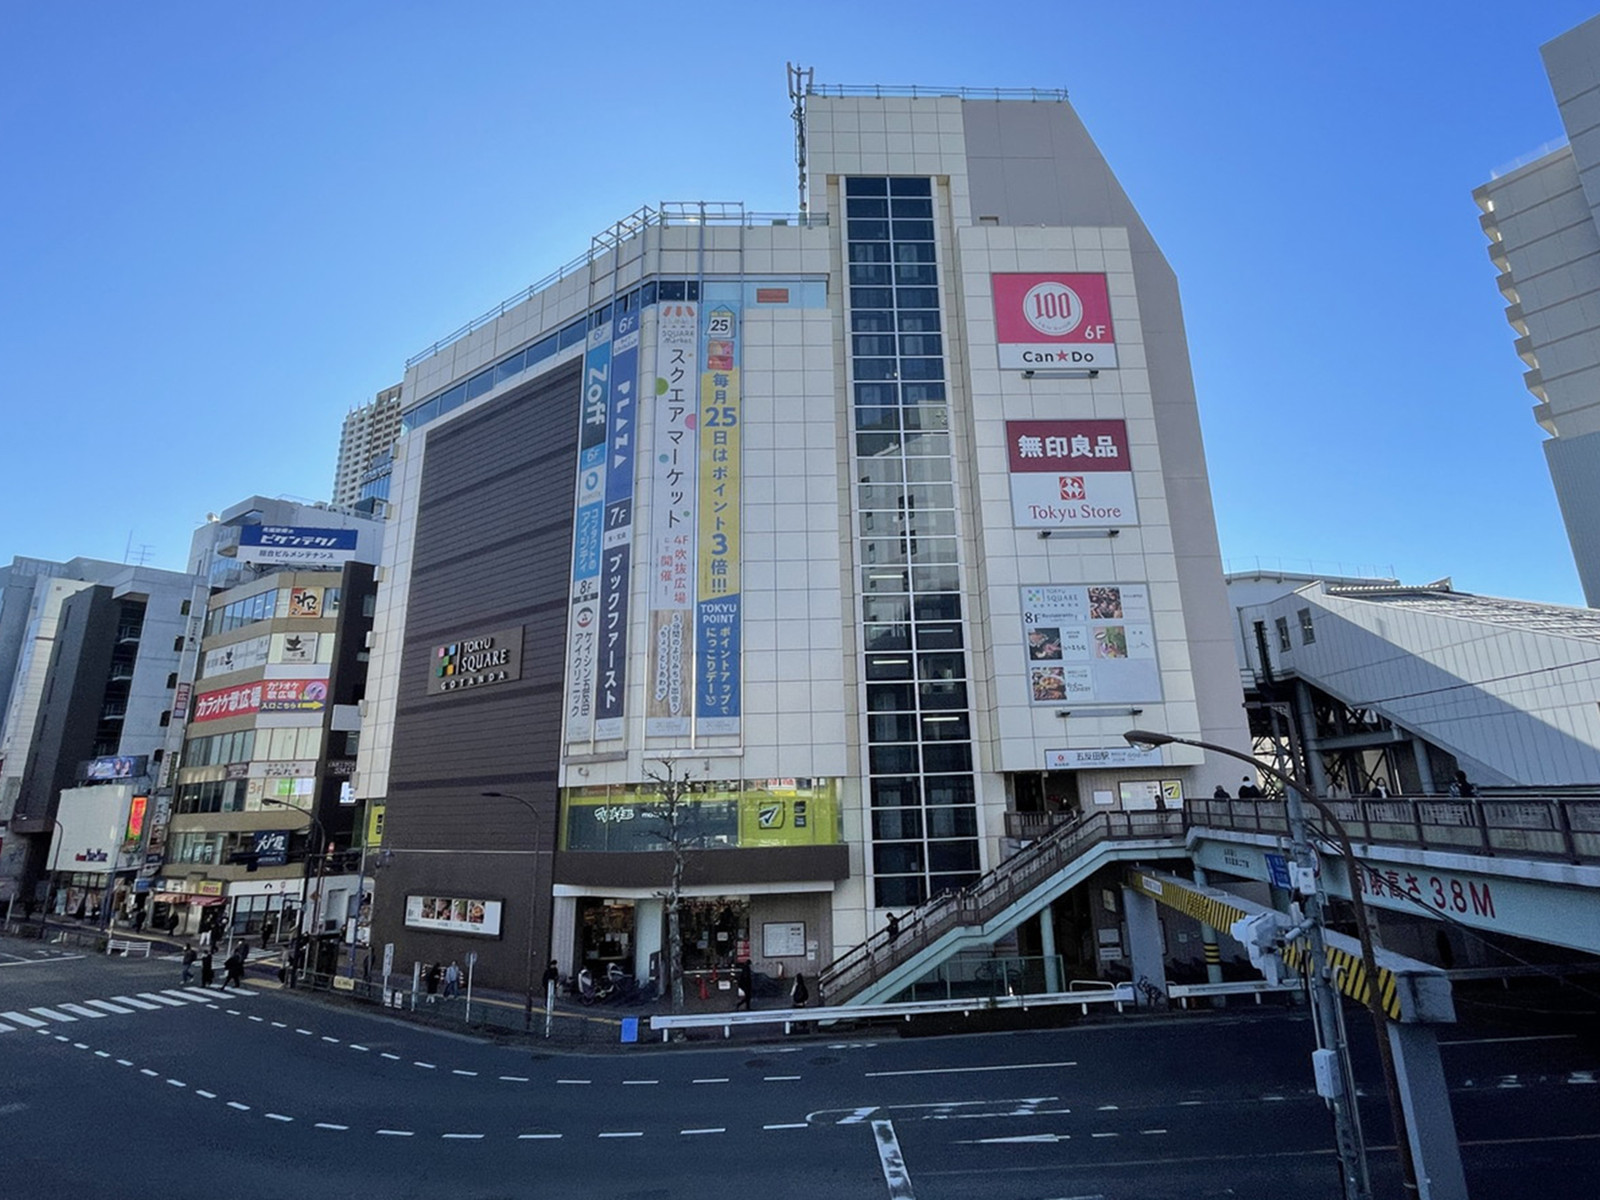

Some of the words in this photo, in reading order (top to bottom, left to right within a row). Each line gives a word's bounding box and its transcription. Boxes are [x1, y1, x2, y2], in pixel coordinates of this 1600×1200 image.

[1033, 292, 1072, 320] 100
[618, 316, 634, 333] 6F
[710, 319, 729, 332] 25
[1084, 325, 1106, 340] 6F
[586, 363, 608, 426] Zoff
[667, 349, 685, 529] スクエアマーケット
[1018, 434, 1119, 458] 無印良品
[610, 507, 627, 527] 7F
[1028, 505, 1077, 523] Tokyu
[1081, 504, 1122, 519] Store
[579, 580, 593, 595] 8F
[700, 604, 737, 613] TOKYU
[1024, 611, 1041, 624] 8F
[703, 614, 735, 624] POINT
[604, 553, 623, 709] ブックファースト
[464, 637, 491, 653] TOKYU
[461, 648, 507, 672] SQUARE
[571, 633, 584, 718] アイクリニック
[720, 626, 731, 714] ポイントアップで
[441, 671, 505, 690] GOTANDA
[1430, 876, 1496, 919] 3.8M
